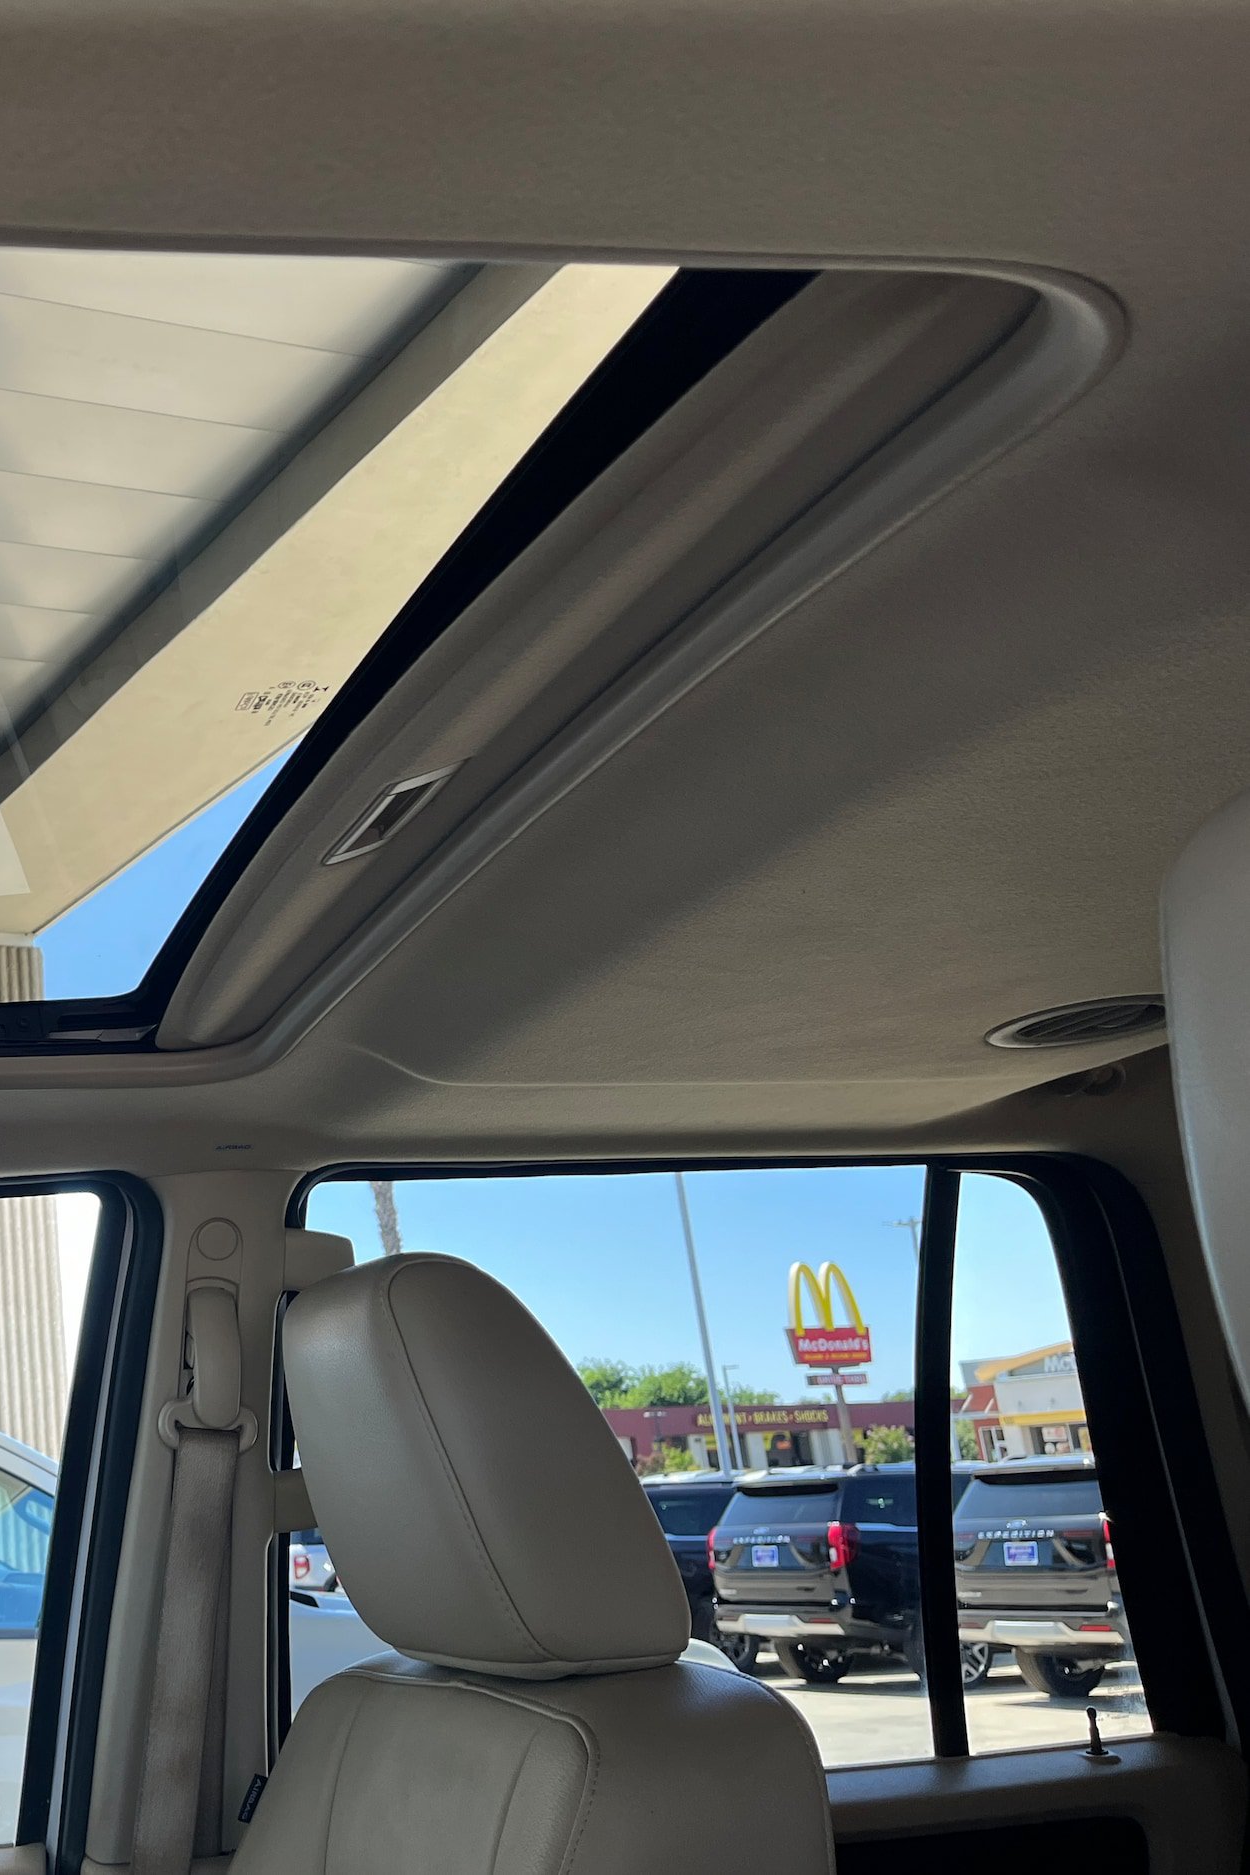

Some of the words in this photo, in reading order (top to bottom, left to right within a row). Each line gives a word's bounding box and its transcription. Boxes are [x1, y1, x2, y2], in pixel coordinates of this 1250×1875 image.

[798, 1338, 869, 1351] McDonald's
[753, 1410, 788, 1425] BRAKES
[793, 1409, 829, 1424] SHOCKS
[978, 1529, 1055, 1539] EXPEDITION
